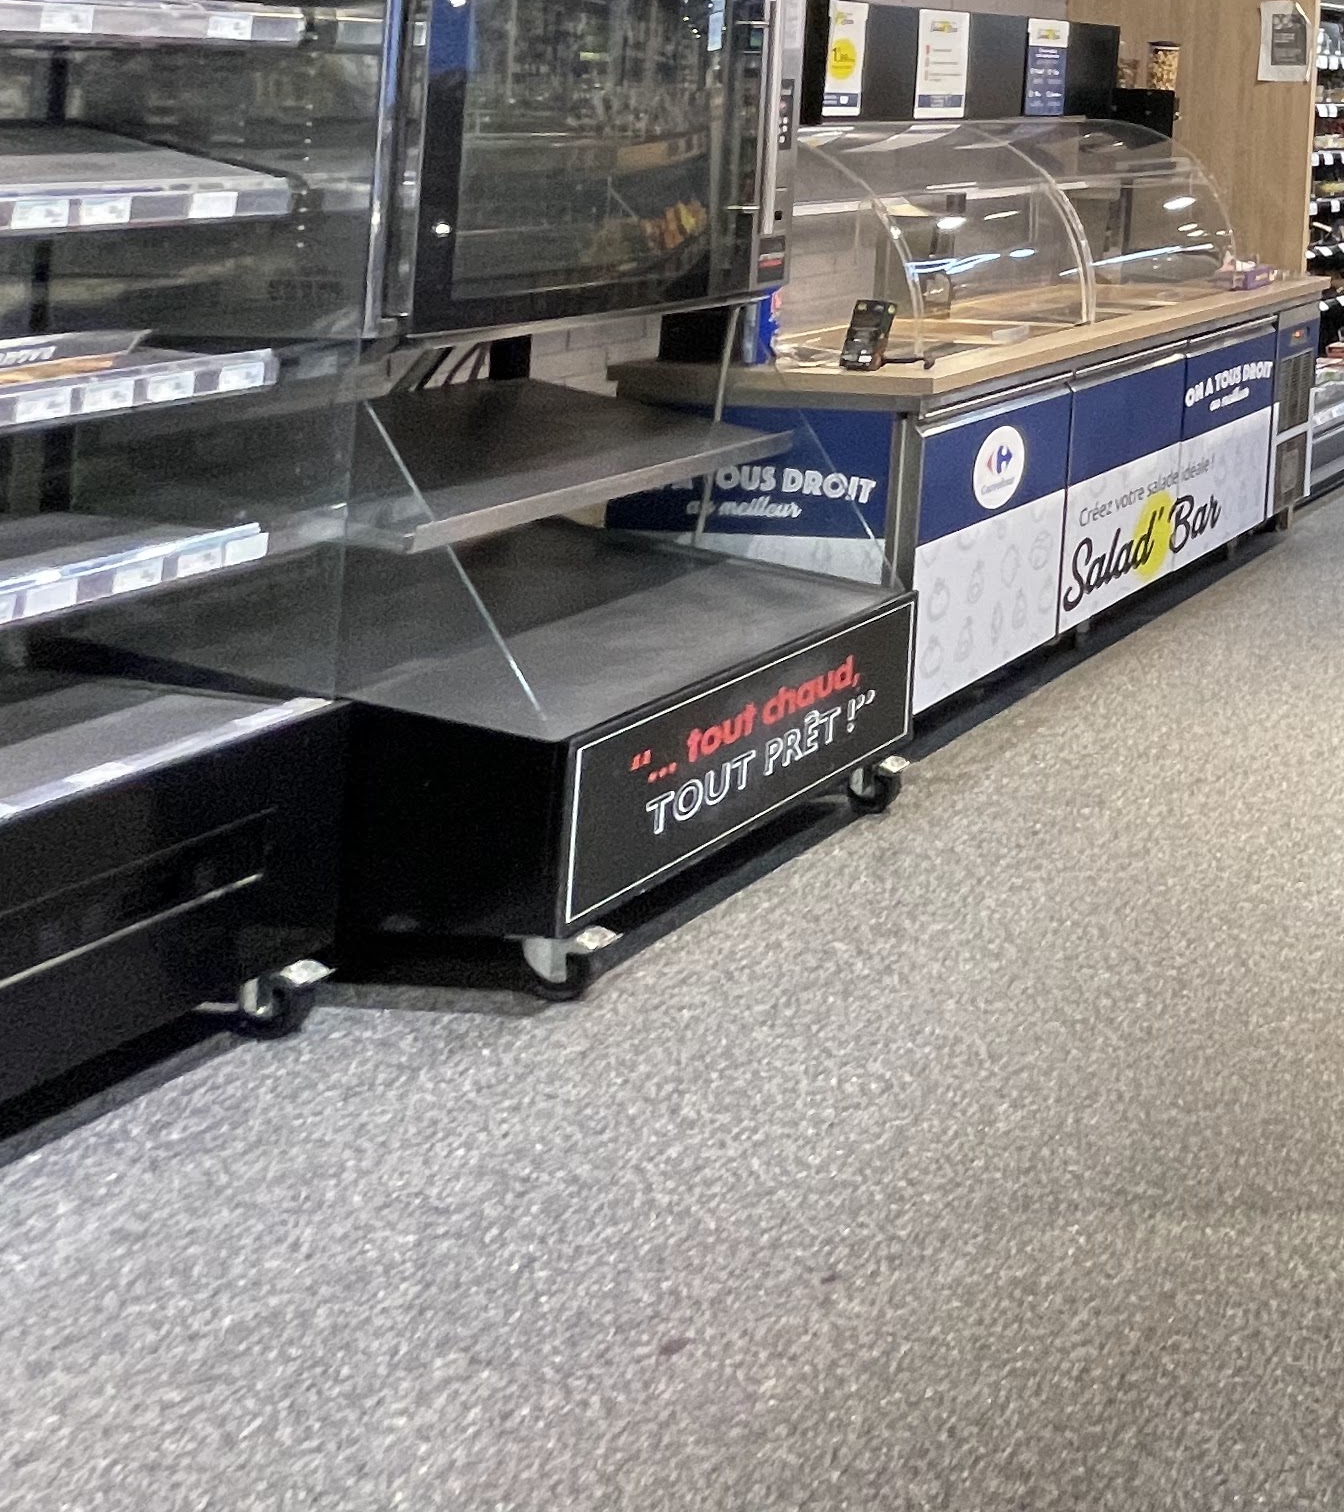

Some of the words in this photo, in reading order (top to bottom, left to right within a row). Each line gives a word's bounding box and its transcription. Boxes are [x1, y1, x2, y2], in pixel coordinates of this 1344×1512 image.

[1204, 377, 1214, 397] A
[1214, 365, 1242, 391] TOUS
[1242, 361, 1273, 381] DROIT
[703, 466, 776, 491] OUS
[782, 468, 877, 503] DROIT
[718, 496, 802, 518] meilleur
[1079, 498, 1112, 527] Créez
[1114, 487, 1145, 510] votre
[1147, 468, 1179, 497] salade
[1169, 494, 1222, 553] Bar
[686, 701, 757, 763] tout
[762, 655, 861, 725] chaud,
[645, 749, 757, 835] TOUT
[763, 705, 842, 776] PRÊT
